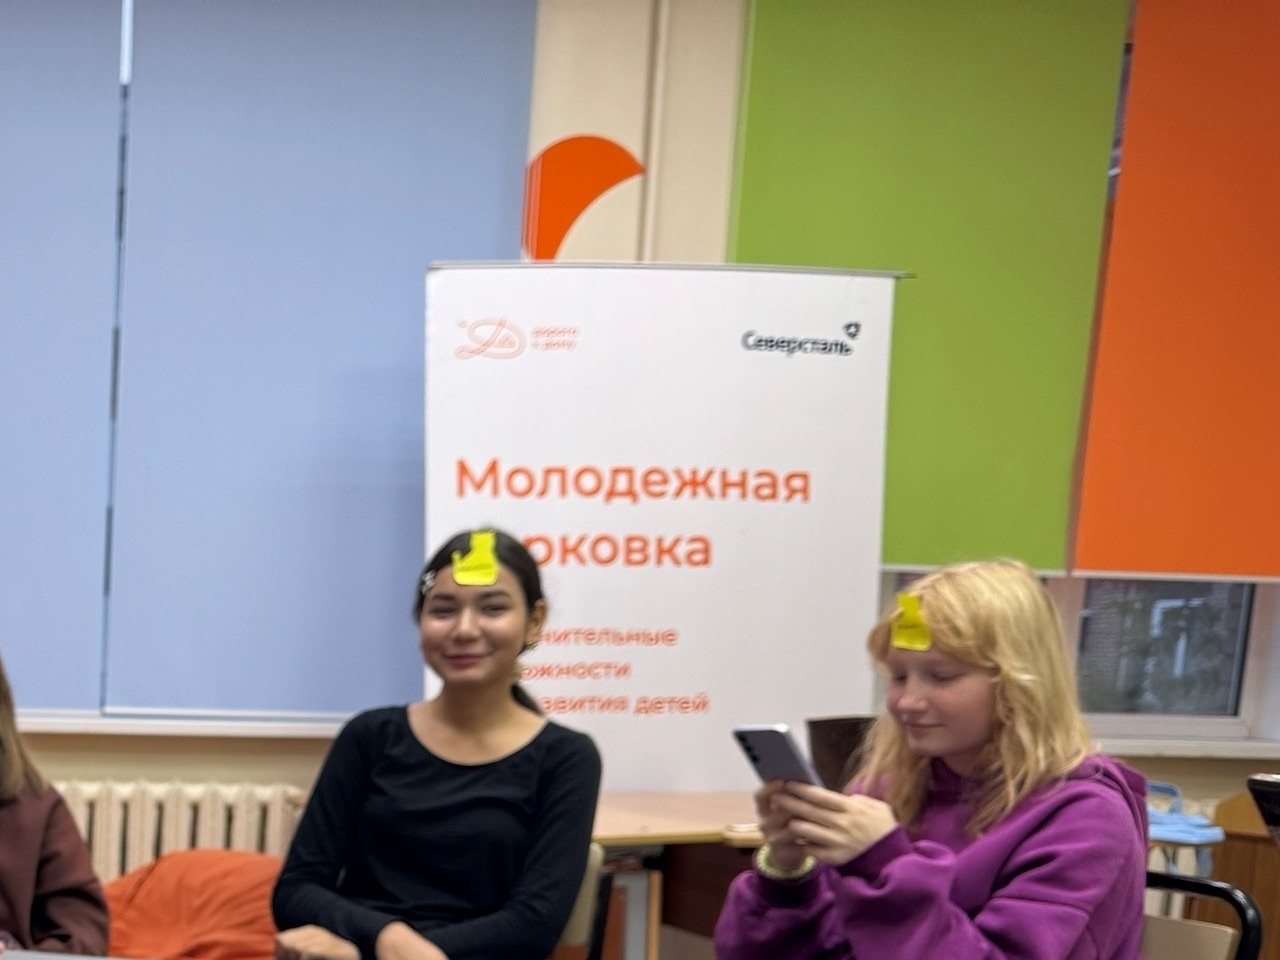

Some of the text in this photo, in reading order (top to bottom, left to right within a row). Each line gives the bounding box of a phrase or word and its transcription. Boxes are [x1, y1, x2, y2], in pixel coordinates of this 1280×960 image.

[741, 330, 853, 357] Северсталь
[455, 458, 812, 505] Молодежная
[521, 533, 713, 568] рковка
[541, 627, 678, 646] нительные
[520, 662, 631, 681] ожности
[540, 691, 711, 717] звития детей
